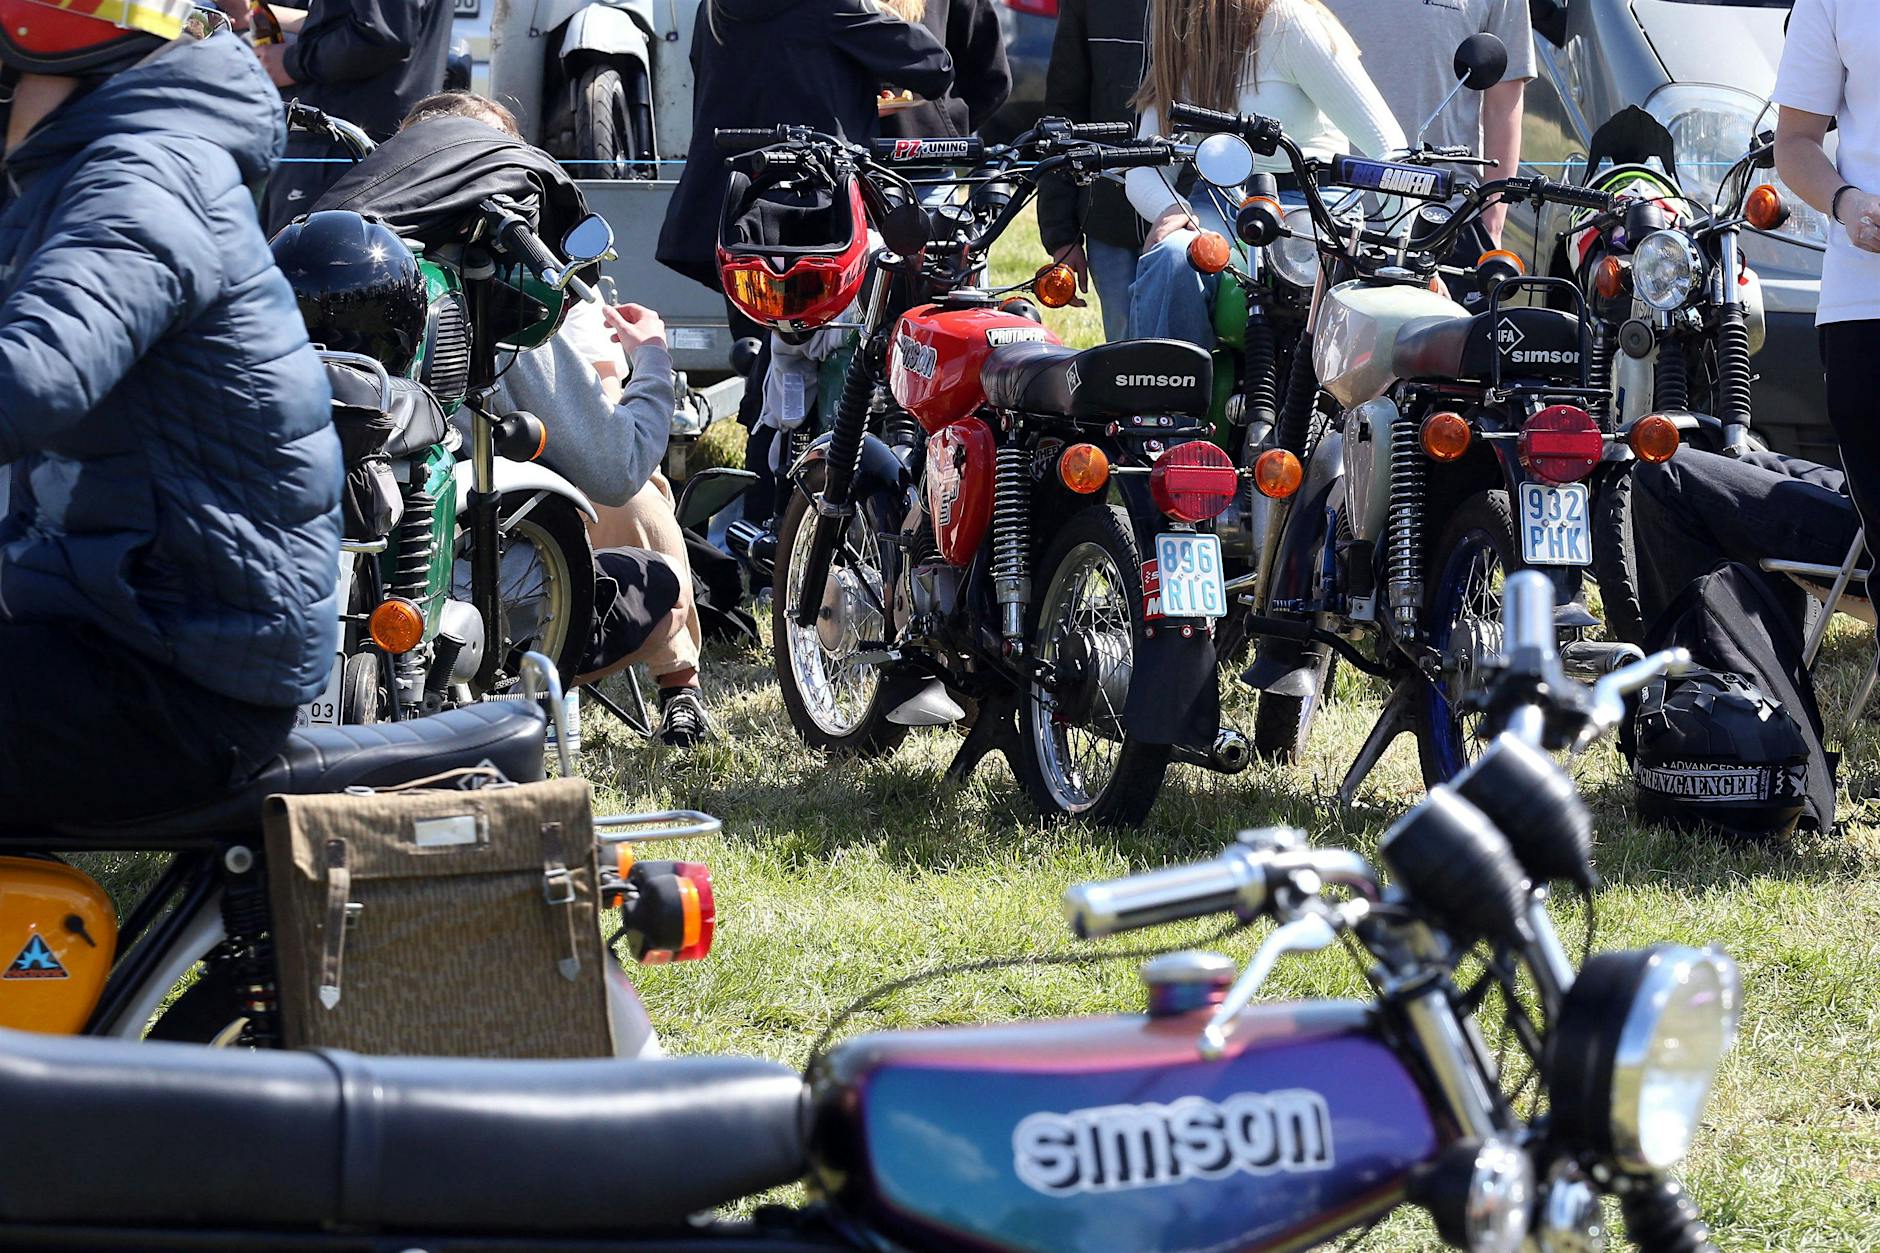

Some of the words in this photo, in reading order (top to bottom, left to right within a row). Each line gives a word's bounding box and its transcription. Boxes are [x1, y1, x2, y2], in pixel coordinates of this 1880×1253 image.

[1379, 168, 1437, 196] SAUFEN
[1497, 330, 1515, 342] IFA
[1115, 374, 1196, 387] simson
[1529, 489, 1581, 520] 932
[1163, 540, 1213, 573] 896
[1530, 526, 1583, 560] PHK
[1168, 578, 1217, 610] RIG
[311, 703, 334, 718] 03
[1639, 767, 1758, 797] GRENZGAENGER
[1013, 1089, 1334, 1197] simson
